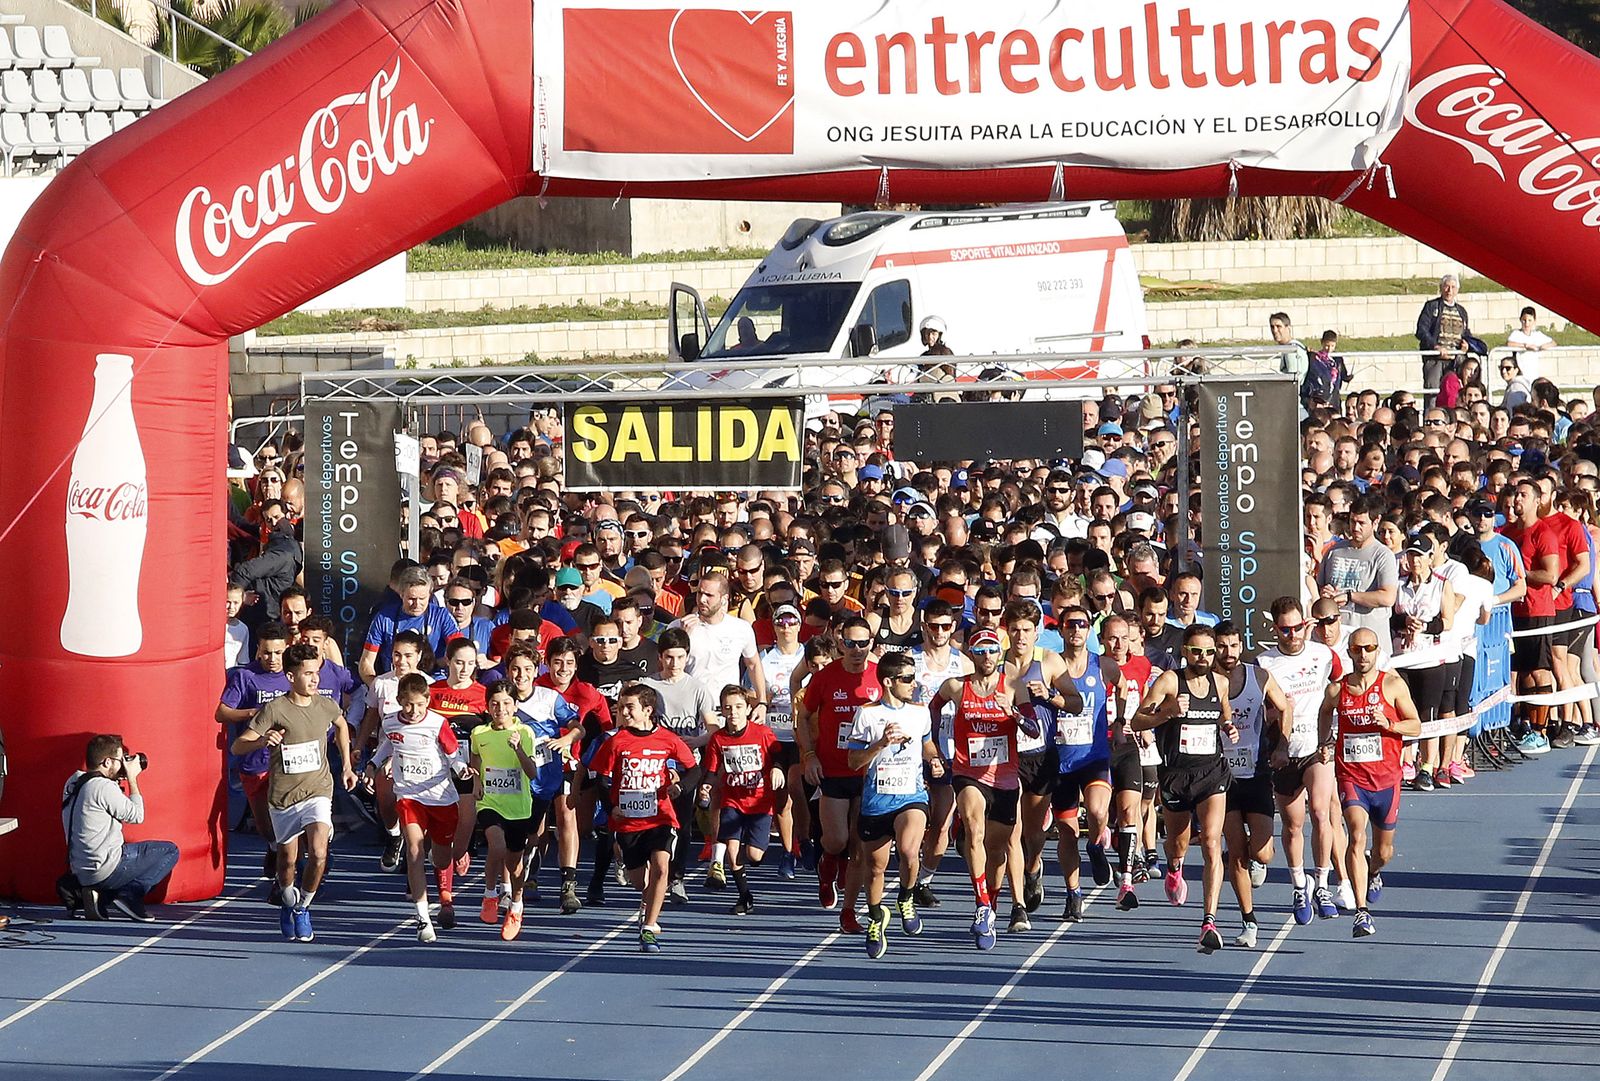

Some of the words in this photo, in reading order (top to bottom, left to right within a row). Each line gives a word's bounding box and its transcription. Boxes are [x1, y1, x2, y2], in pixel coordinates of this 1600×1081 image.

[774, 17, 787, 62] ALEGRÍA
[824, 2, 1383, 97] entreculturas
[777, 63, 787, 72] Y
[777, 74, 787, 86] FE
[826, 126, 874, 142] ONG
[880, 125, 963, 142] JESUITA
[970, 124, 1022, 140] PARA
[1029, 123, 1053, 139] LA
[1061, 115, 1186, 138] EDUCACIÓN
[1193, 118, 1205, 134] Y
[1212, 117, 1237, 133] EL
[1244, 110, 1381, 132] DESARROLLO
[174, 56, 435, 286] Coca-Cola
[950, 248, 991, 261] SOPORTE
[991, 245, 1014, 257] VITAL
[1015, 241, 1060, 256] AVANZADO
[571, 405, 801, 463] SALIDA
[1216, 395, 1231, 471] deportivos
[320, 415, 335, 490] deportivos
[1231, 391, 1258, 514] Tempo
[335, 411, 362, 533] Tempo
[68, 480, 147, 521] Coca-Cola
[1217, 473, 1231, 529] eventos
[320, 493, 332, 549] eventos
[1218, 533, 1230, 551] de
[320, 551, 332, 570] de
[441, 700, 469, 712] Bahía
[1067, 728, 1079, 738] 97
[980, 748, 998, 759] 317
[1351, 743, 1374, 755] 4508
[290, 754, 315, 766] 4343
[403, 764, 428, 775] 4263
[491, 777, 515, 788] 4264
[885, 776, 909, 787] 4287
[627, 799, 650, 811] 4030
